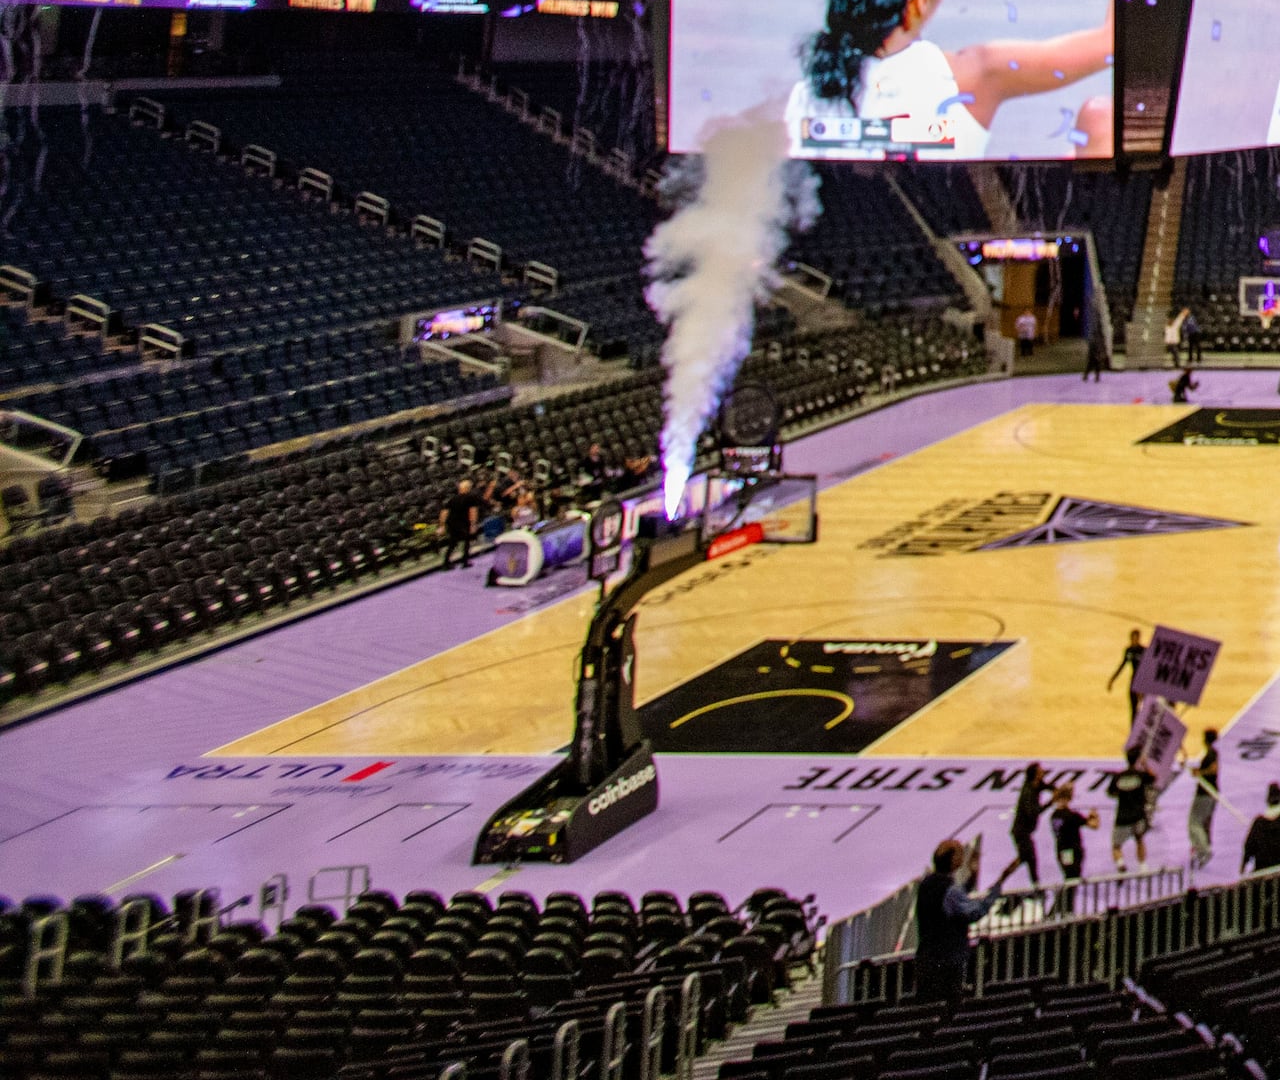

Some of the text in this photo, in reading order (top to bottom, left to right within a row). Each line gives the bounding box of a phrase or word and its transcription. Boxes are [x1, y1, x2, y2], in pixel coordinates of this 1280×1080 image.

[1155, 662, 1194, 690] WIN
[164, 764, 346, 783] ULTRA
[782, 767, 967, 791] STATE
[588, 765, 657, 816] coinbase
